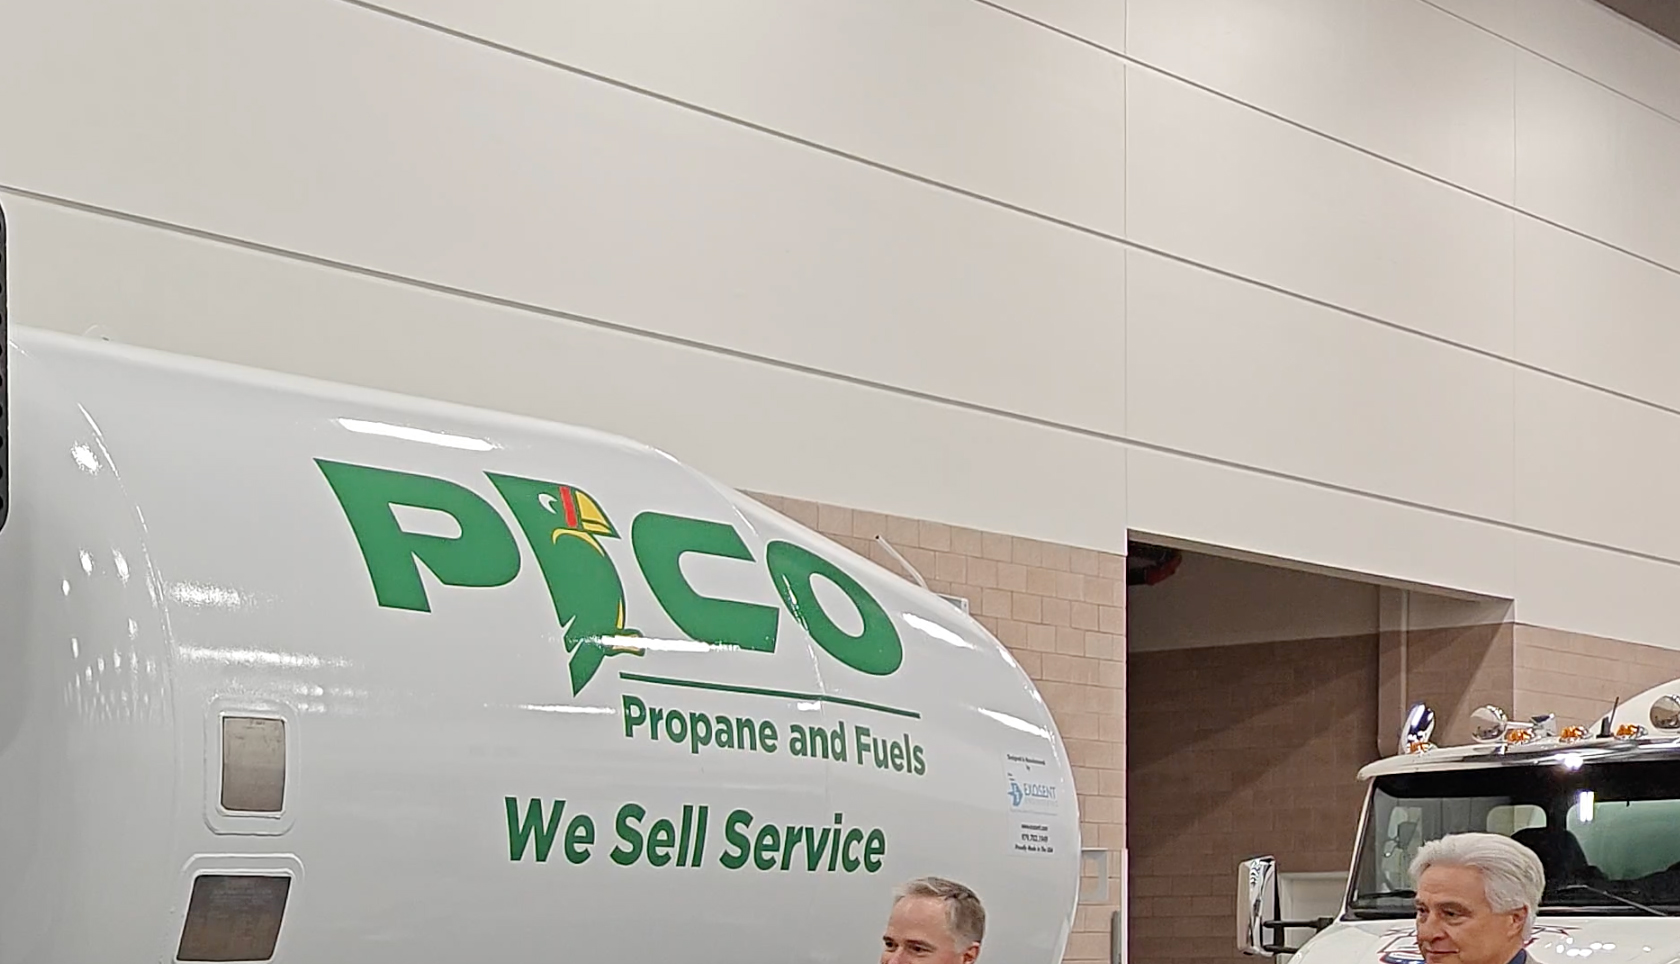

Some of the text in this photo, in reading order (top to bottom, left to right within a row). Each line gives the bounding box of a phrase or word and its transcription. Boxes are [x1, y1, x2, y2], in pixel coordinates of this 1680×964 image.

[313, 457, 904, 698] PICO
[621, 694, 927, 776] Propane and Fuels
[504, 796, 886, 873] We Sell Service
